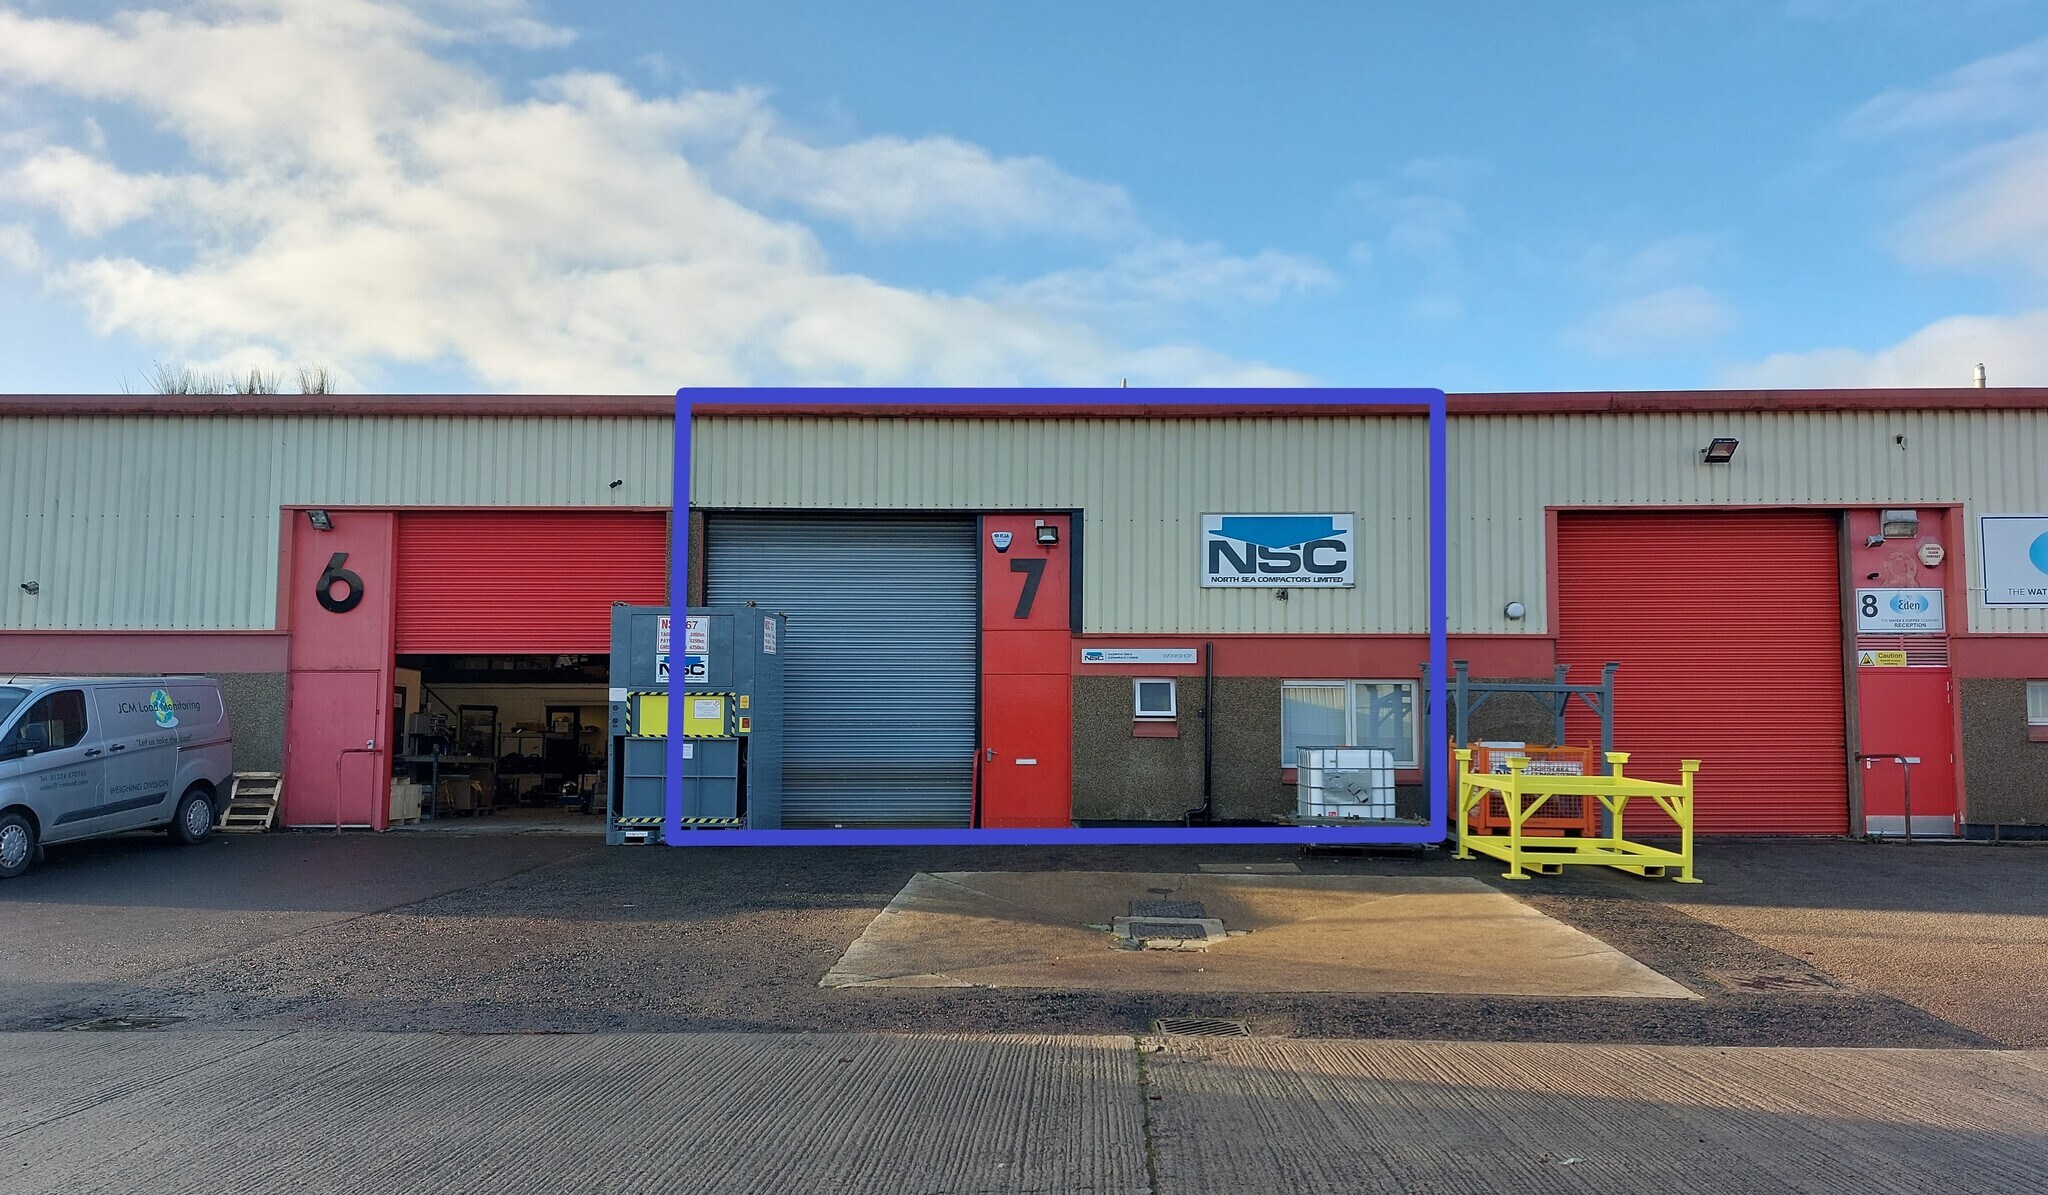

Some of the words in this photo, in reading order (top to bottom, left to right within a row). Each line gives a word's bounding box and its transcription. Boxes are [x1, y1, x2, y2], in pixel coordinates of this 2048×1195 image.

[1209, 540, 1347, 574] NSC
[316, 552, 364, 613] 6
[1010, 559, 1047, 619] 7
[1862, 594, 1878, 618] 8
[1898, 600, 1920, 610] Eden
[118, 702, 137, 713] JCM
[139, 702, 158, 712] Load
[162, 700, 200, 711] Monitoring
[110, 783, 142, 794] WEIGHING
[143, 780, 168, 790] DIVISION
